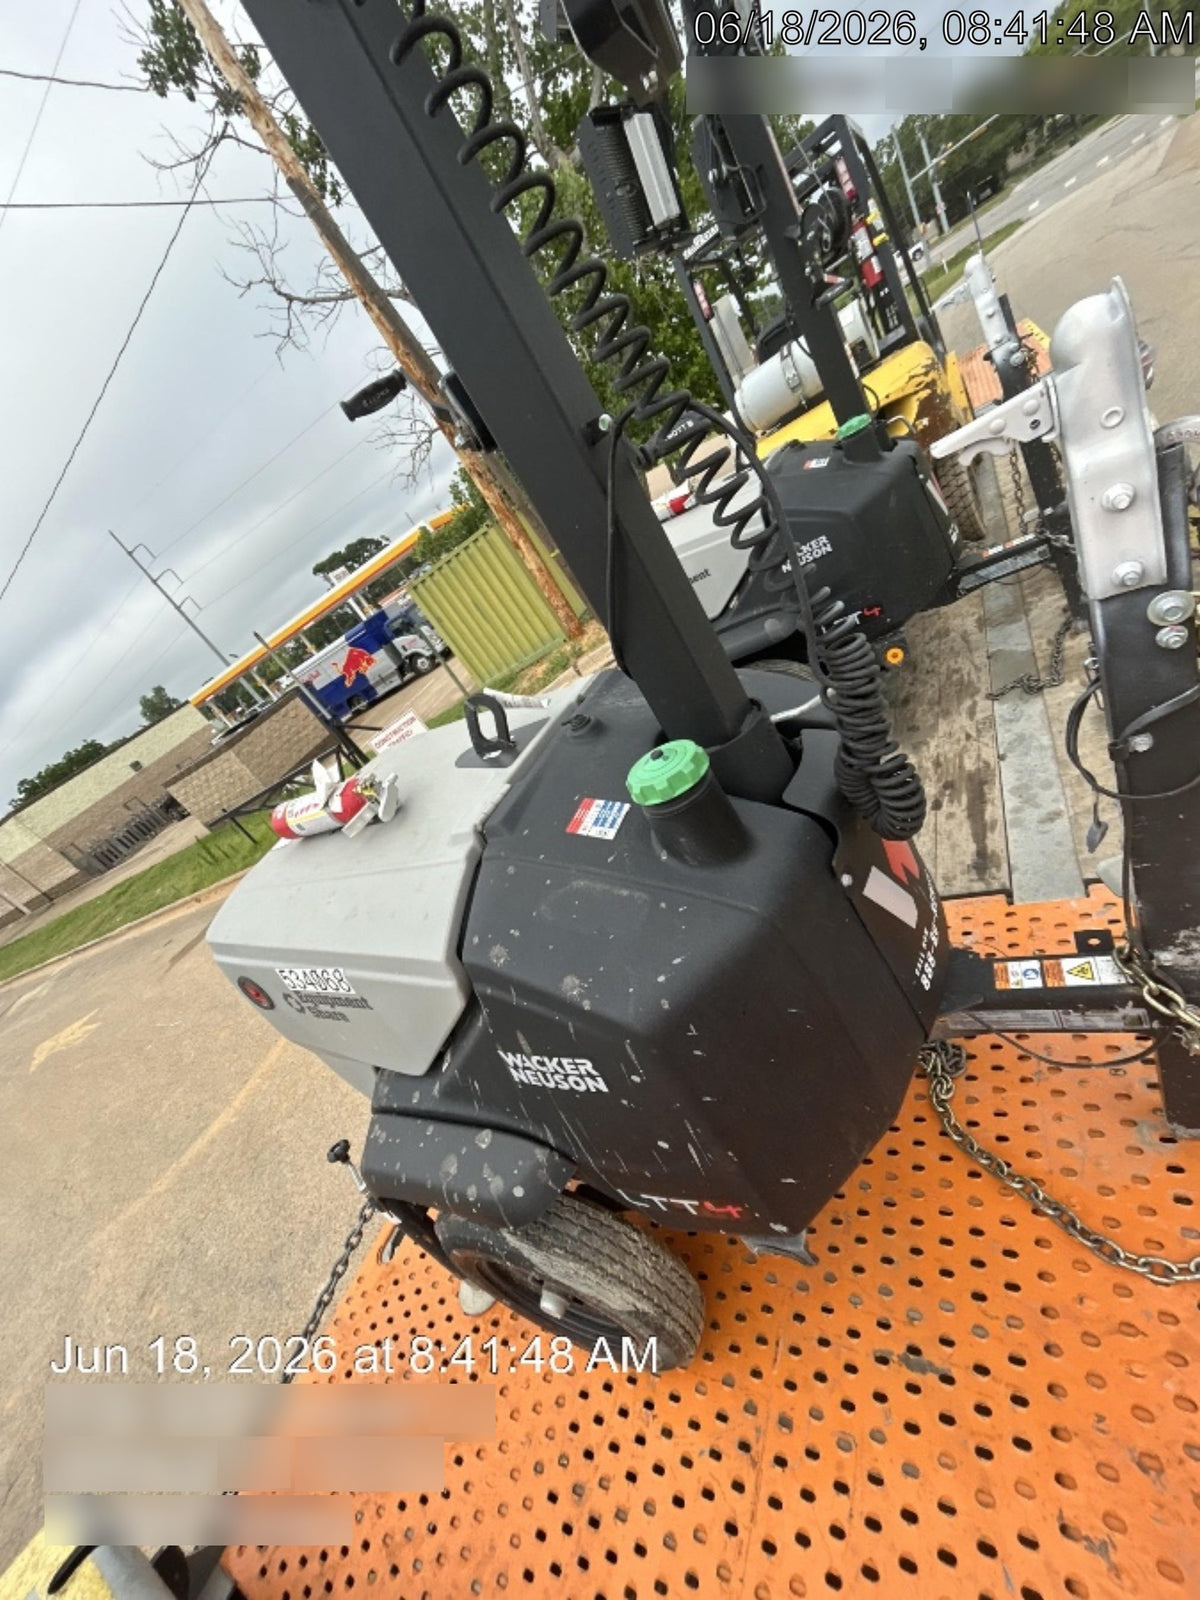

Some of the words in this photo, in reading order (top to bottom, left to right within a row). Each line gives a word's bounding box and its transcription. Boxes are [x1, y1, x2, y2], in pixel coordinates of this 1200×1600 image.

[781, 543, 832, 573] NUSON
[497, 1050, 600, 1076] WACKER
[509, 1067, 609, 1092] NEUSON
